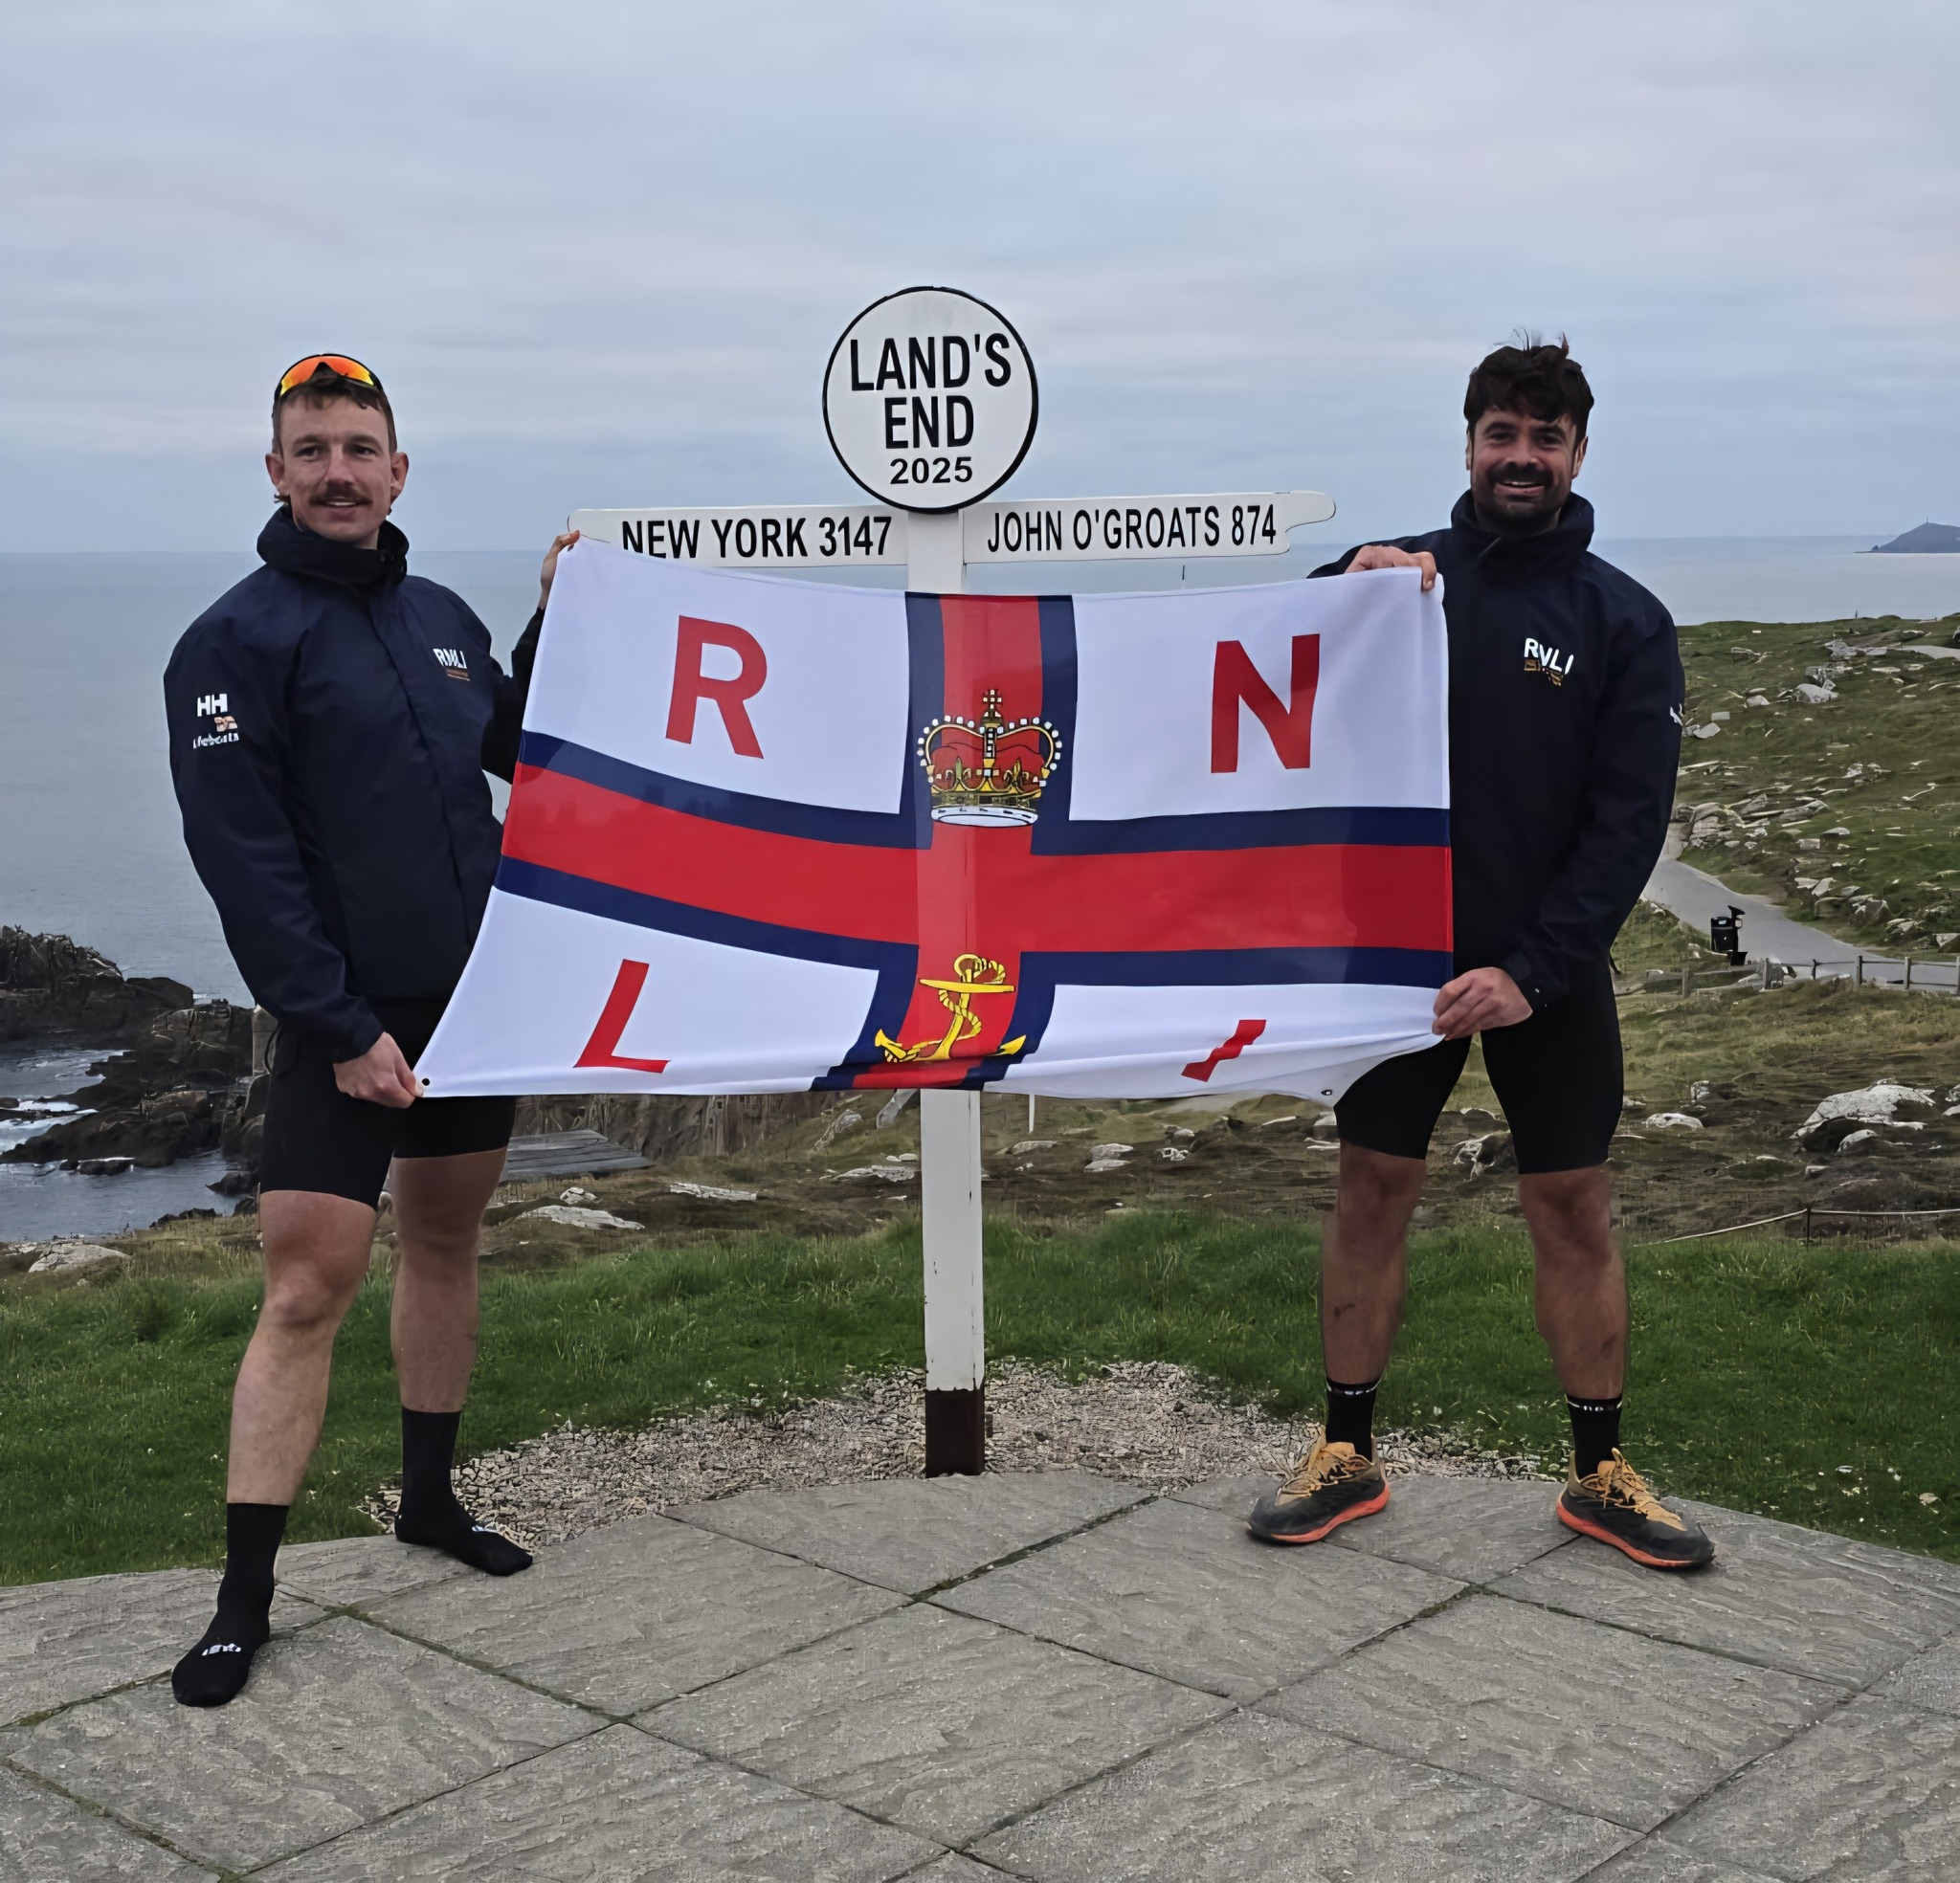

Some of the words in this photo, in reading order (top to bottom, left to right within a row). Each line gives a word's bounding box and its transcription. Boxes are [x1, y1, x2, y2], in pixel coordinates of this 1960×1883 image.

[850, 332, 1013, 391] LAND'S
[884, 395, 974, 450] END
[890, 456, 973, 485] 2025
[621, 519, 701, 560] NEW
[711, 517, 809, 559] YORK
[818, 515, 892, 557] 3147
[987, 510, 1062, 553] JOHN
[1073, 505, 1220, 551] O'GROATS
[1231, 503, 1277, 546] 874
[665, 615, 768, 759] R
[1211, 634, 1320, 774] N
[575, 959, 669, 1074] L
